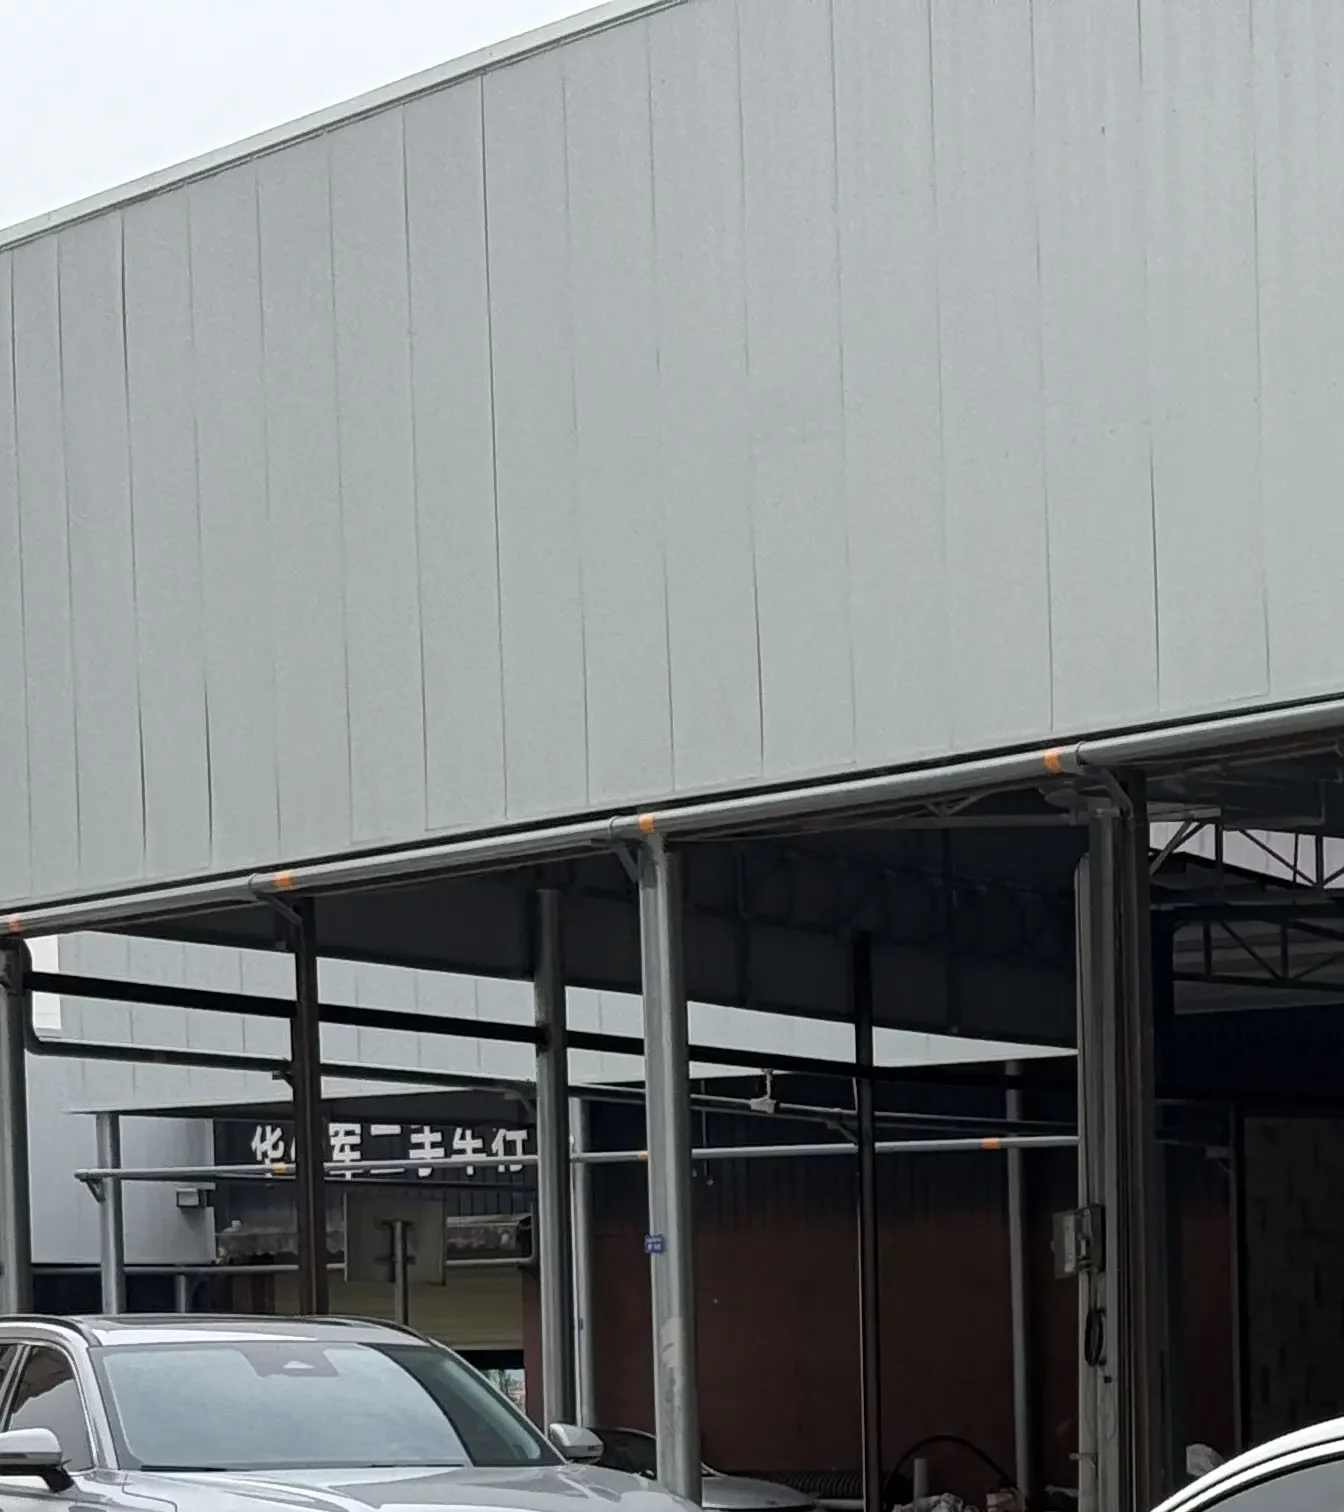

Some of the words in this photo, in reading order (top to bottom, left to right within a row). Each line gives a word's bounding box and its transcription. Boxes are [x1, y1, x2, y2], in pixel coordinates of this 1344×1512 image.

[252, 1121, 528, 1185] 华军二手车行
